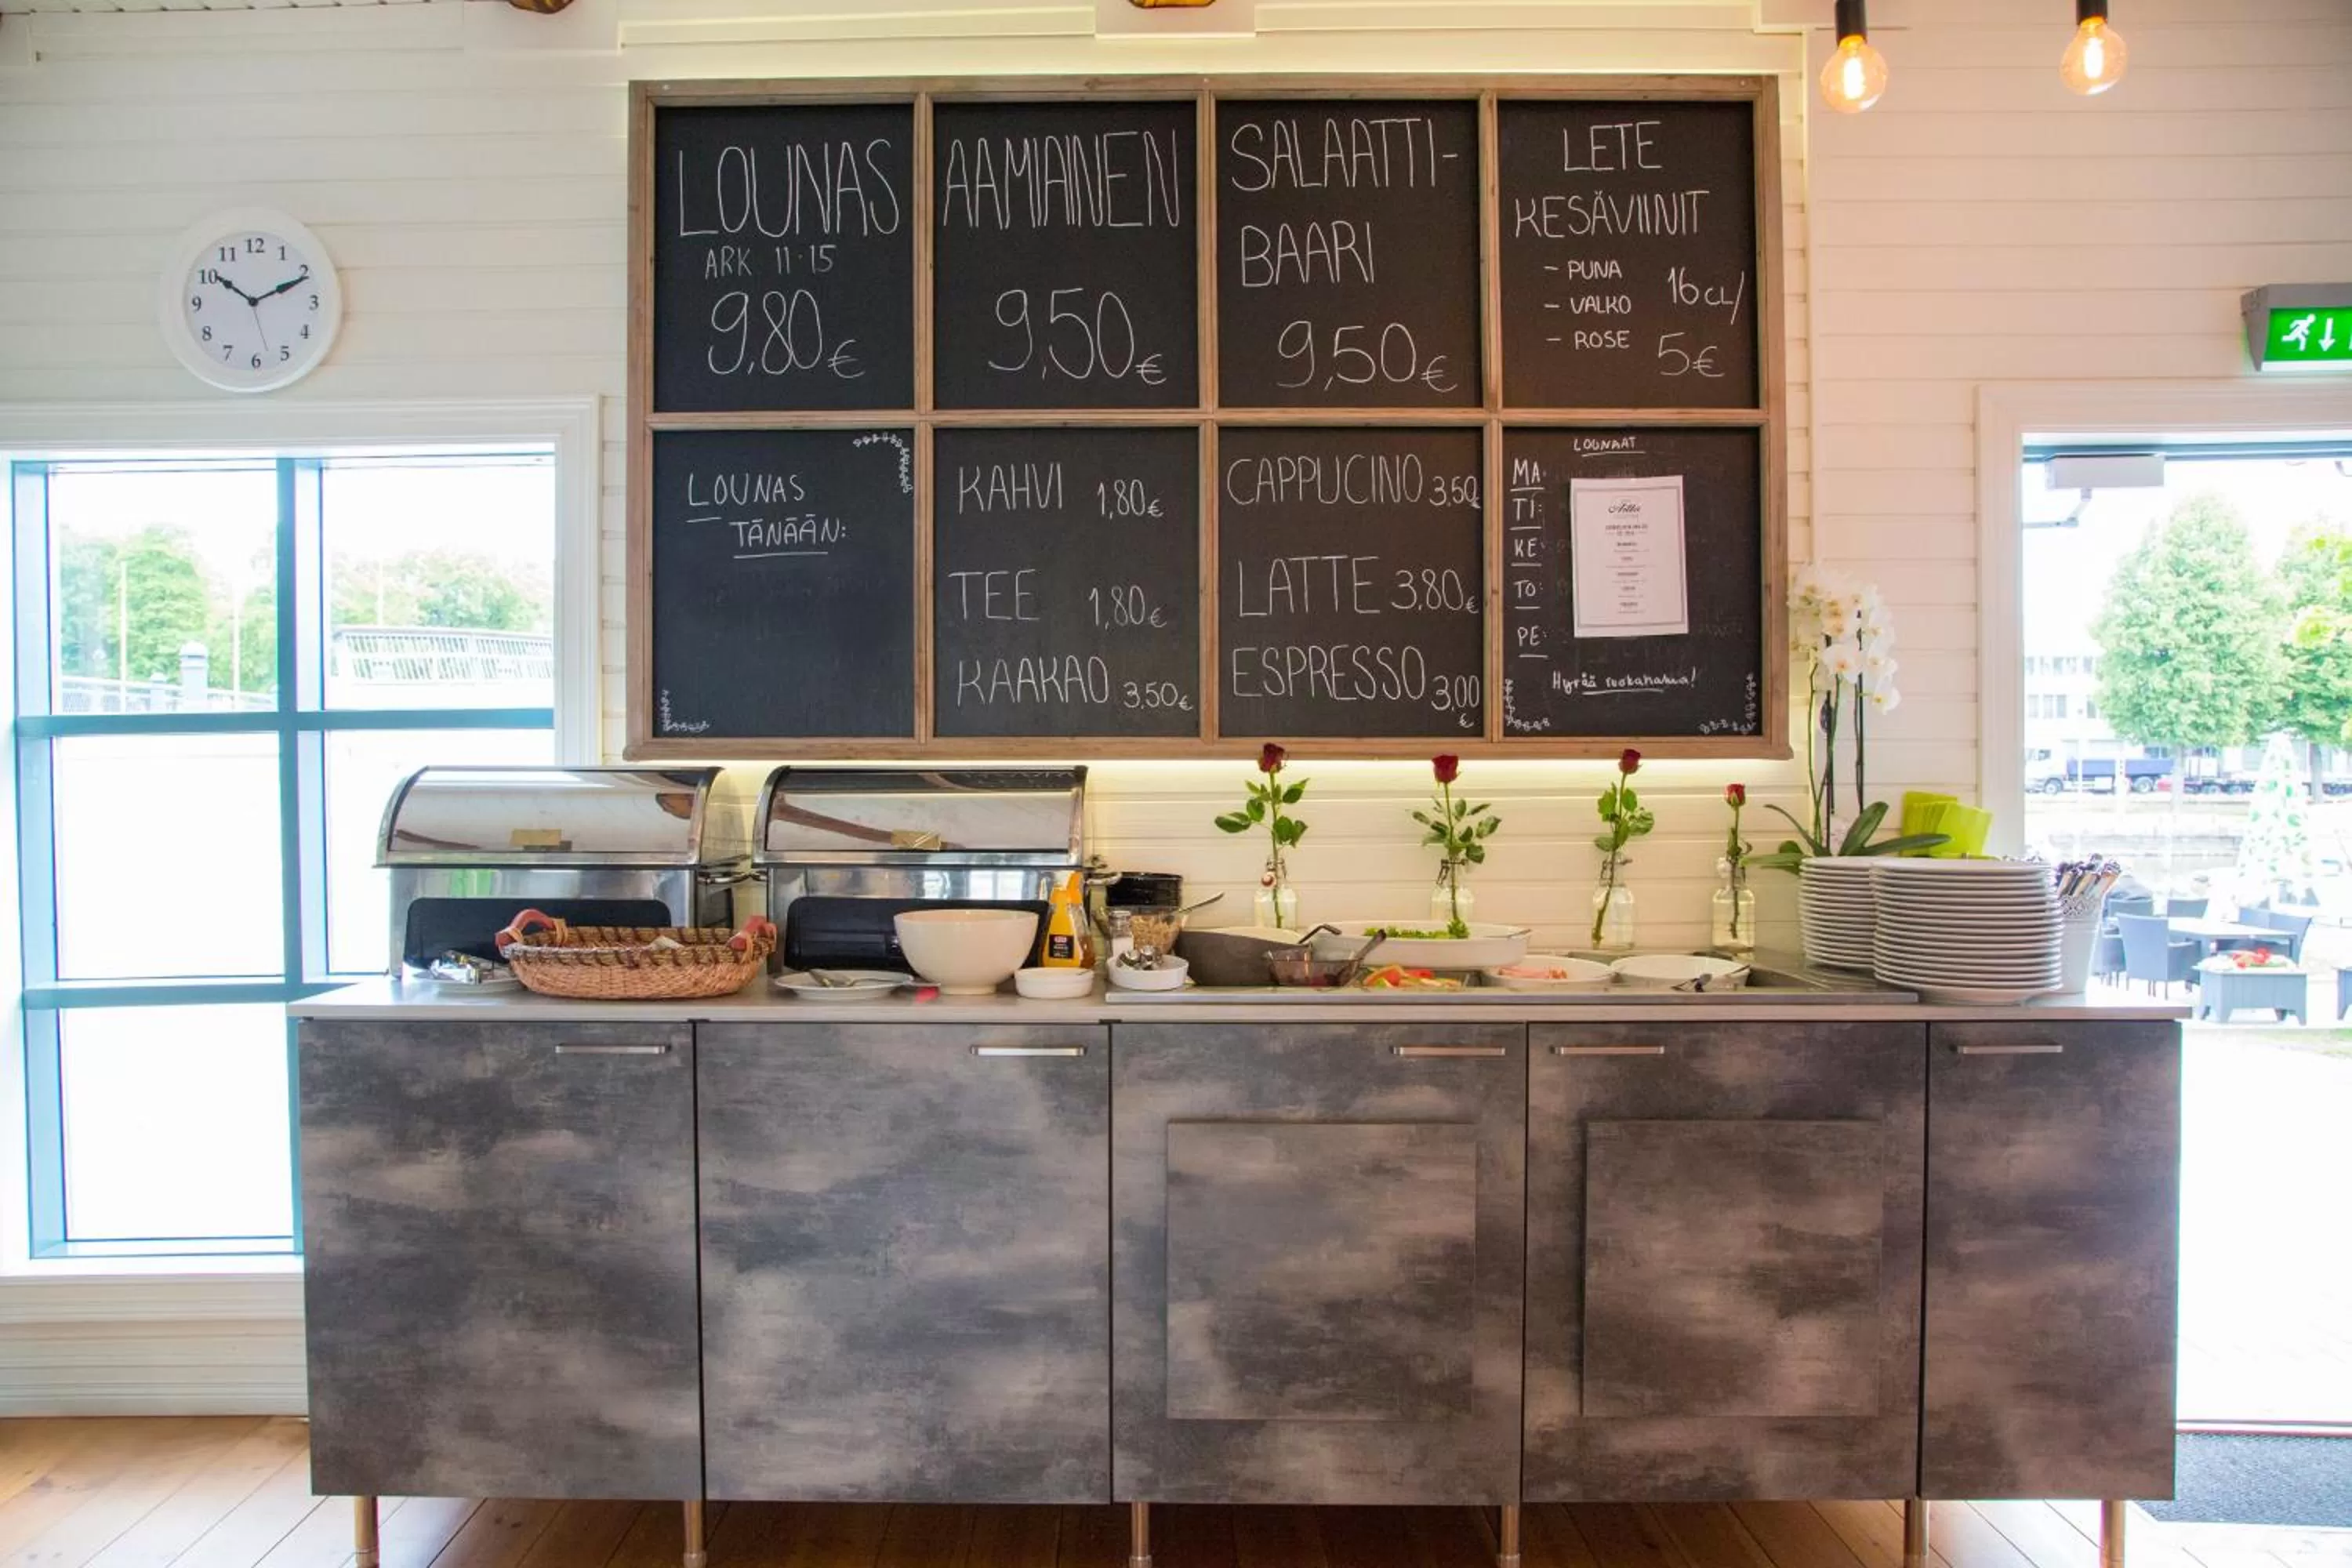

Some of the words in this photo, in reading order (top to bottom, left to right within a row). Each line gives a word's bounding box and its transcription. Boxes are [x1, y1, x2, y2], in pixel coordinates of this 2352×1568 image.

[1231, 118, 1459, 192] SALAATTI-
[1563, 120, 1663, 172] LETE
[679, 138, 899, 238] LOUNAS
[943, 129, 1180, 231] AAMIAINEN
[1515, 190, 1710, 239] KESÄVIINIT
[218, 247, 237, 262] 11
[245, 238, 265, 253] 12
[278, 245, 288, 261] 1
[705, 245, 753, 280] ARK
[1241, 220, 1374, 288] BAARI
[1567, 260, 1623, 281] PUNA
[192, 296, 201, 311] 9
[308, 295, 319, 310] 3
[1570, 294, 1632, 314] VALKO
[201, 326, 212, 341] 8
[300, 325, 310, 339] 4
[1573, 329, 1630, 350] ROSE
[223, 345, 233, 360] 7
[251, 354, 261, 369] 6
[280, 346, 289, 361] 5
[1657, 332, 1725, 378] 5€
[688, 472, 805, 506] LOUNAS
[959, 463, 1063, 515] KAHVI
[1226, 453, 1423, 506] CAPPUCINO
[948, 568, 1040, 621] TEE
[1238, 554, 1381, 618] LATTE
[957, 655, 1109, 706] KAAKAO
[1232, 644, 1426, 701] ESPRESSO
